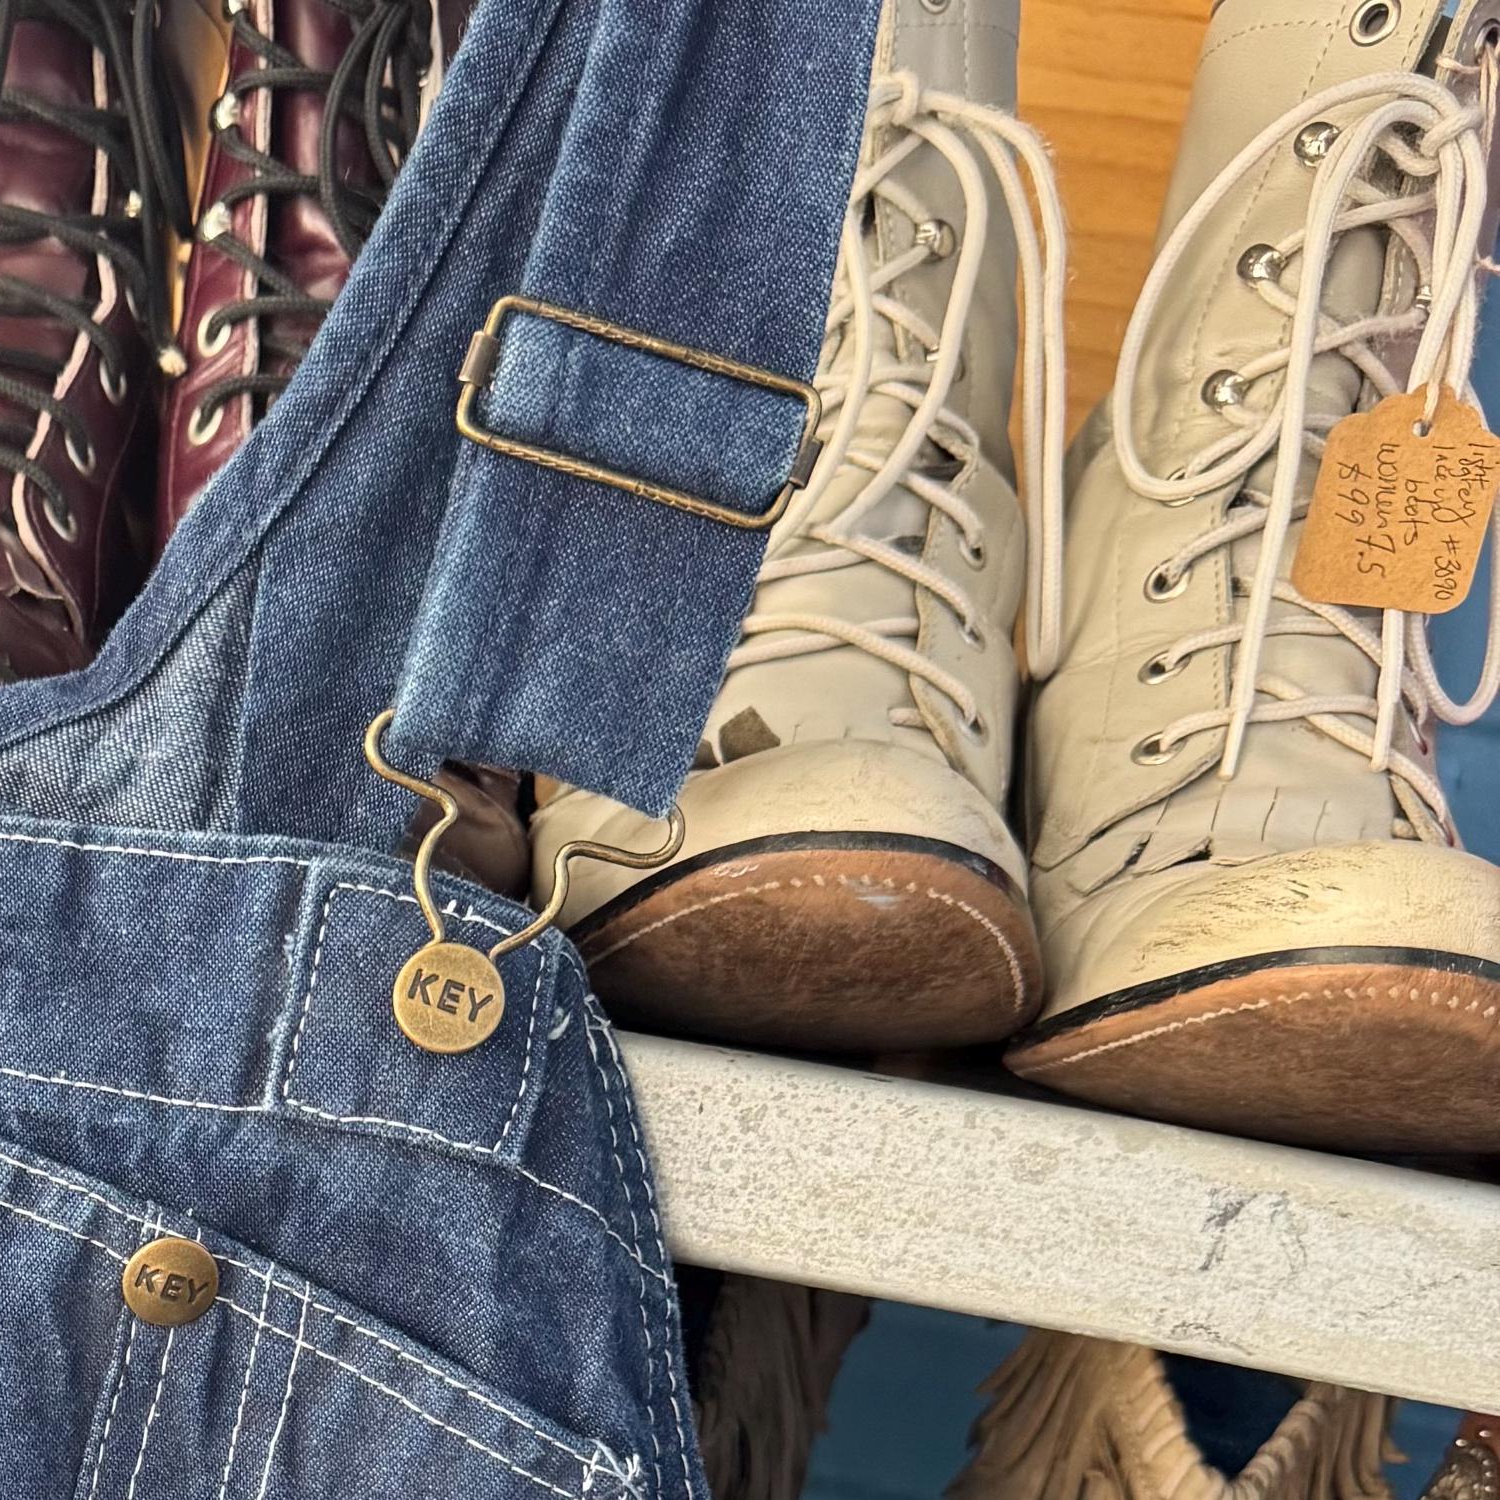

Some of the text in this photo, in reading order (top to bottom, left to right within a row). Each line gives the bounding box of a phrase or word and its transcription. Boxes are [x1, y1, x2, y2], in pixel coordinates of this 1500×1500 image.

[1335, 461, 1372, 527] $99
[1457, 442, 1498, 490] light
[1398, 478, 1429, 545] boots
[1432, 467, 1477, 528] grey
[1355, 533, 1396, 578] 7.5
[1433, 534, 1462, 601] #3090
[407, 967, 494, 1023] KEY
[134, 1263, 210, 1304] KEY
